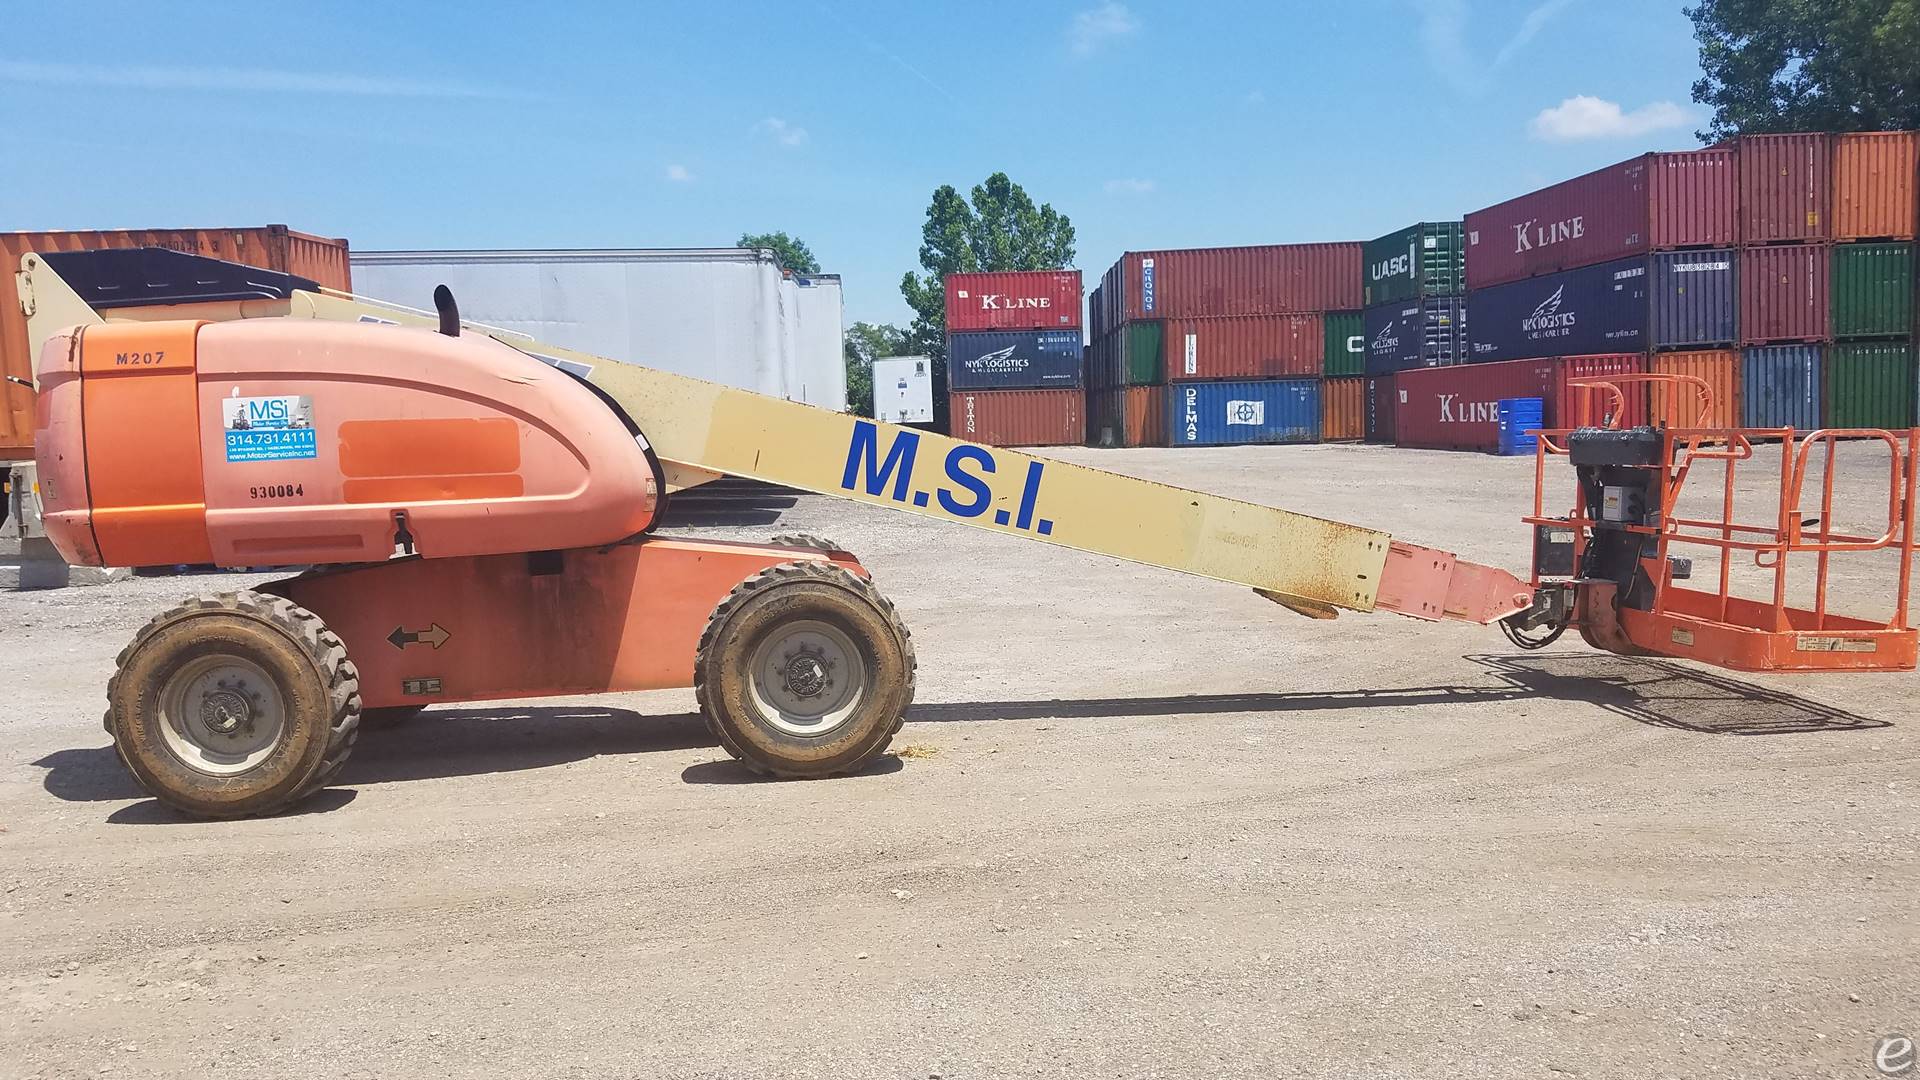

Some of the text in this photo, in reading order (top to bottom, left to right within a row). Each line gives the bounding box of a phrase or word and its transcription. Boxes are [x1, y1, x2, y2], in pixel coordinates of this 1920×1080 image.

[1538, 216, 1585, 247] LINE
[1372, 254, 1408, 280] UASC
[1006, 298, 1051, 309] LINE
[116, 351, 165, 365] M207
[964, 359, 1029, 368] NYK LOGISTICS
[965, 396, 975, 432] TRITON
[1185, 388, 1198, 441] DELMAS
[1459, 402, 1499, 422] LINE
[227, 431, 314, 446] 314.731.4111
[841, 420, 1053, 536] M.S.I.
[250, 484, 304, 499] 930084
